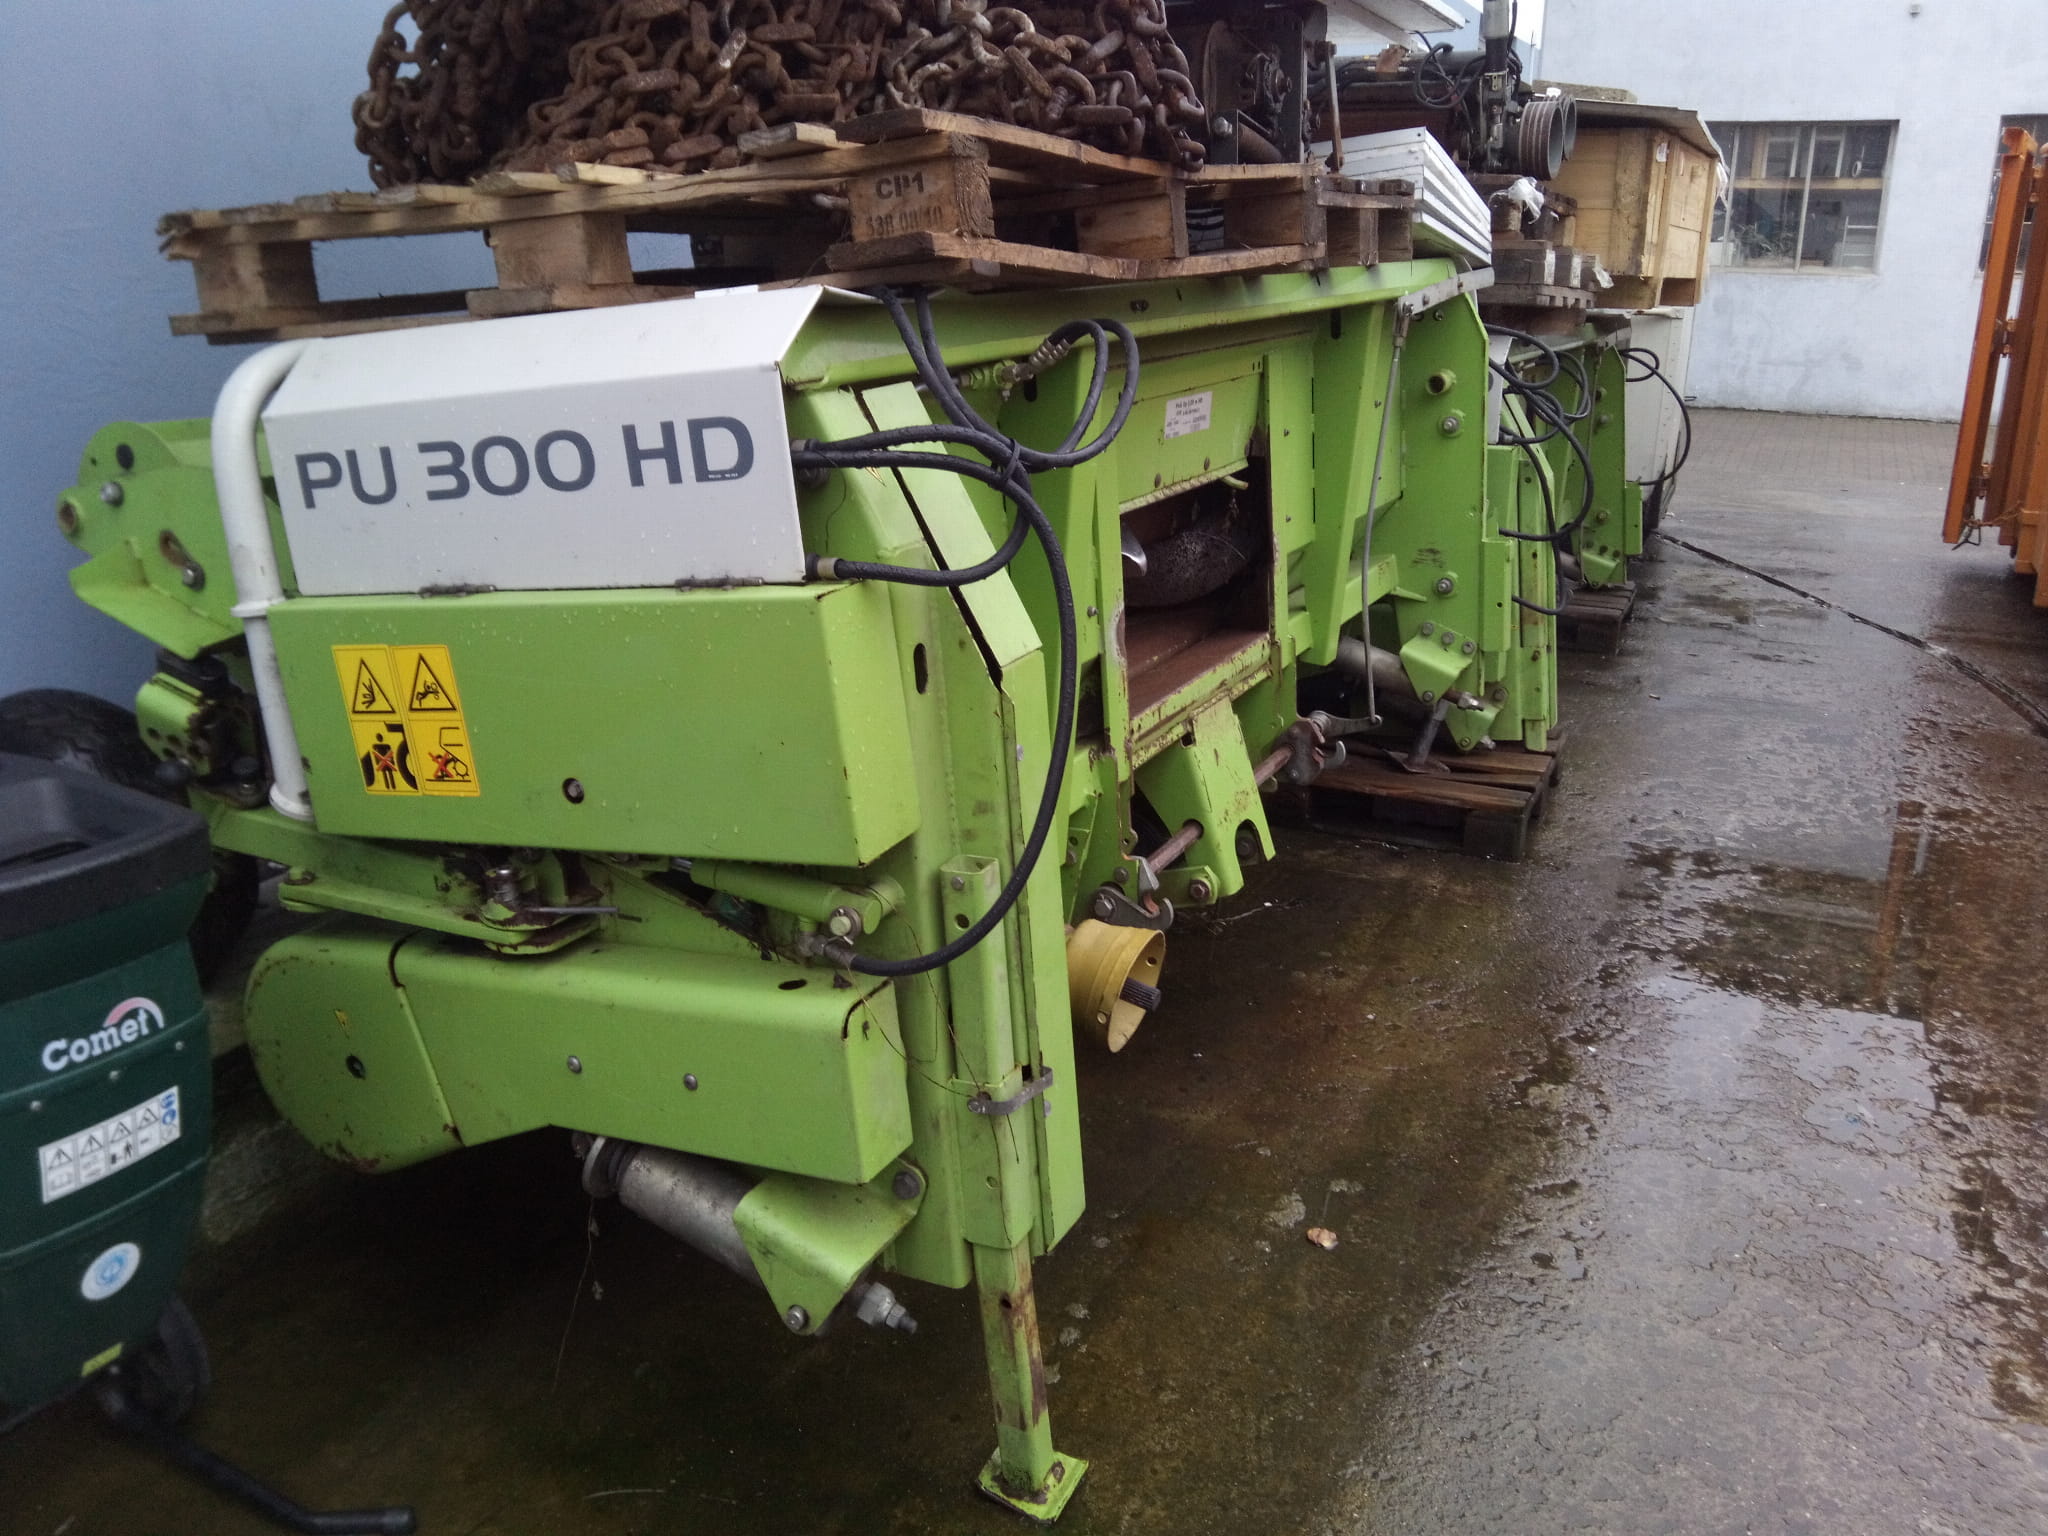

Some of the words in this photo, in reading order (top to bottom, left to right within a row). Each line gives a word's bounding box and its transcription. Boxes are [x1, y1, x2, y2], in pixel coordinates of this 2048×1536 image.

[295, 446, 397, 509] PU
[418, 430, 596, 501] 300
[621, 416, 755, 487] HD
[42, 1008, 150, 1072] Comet
